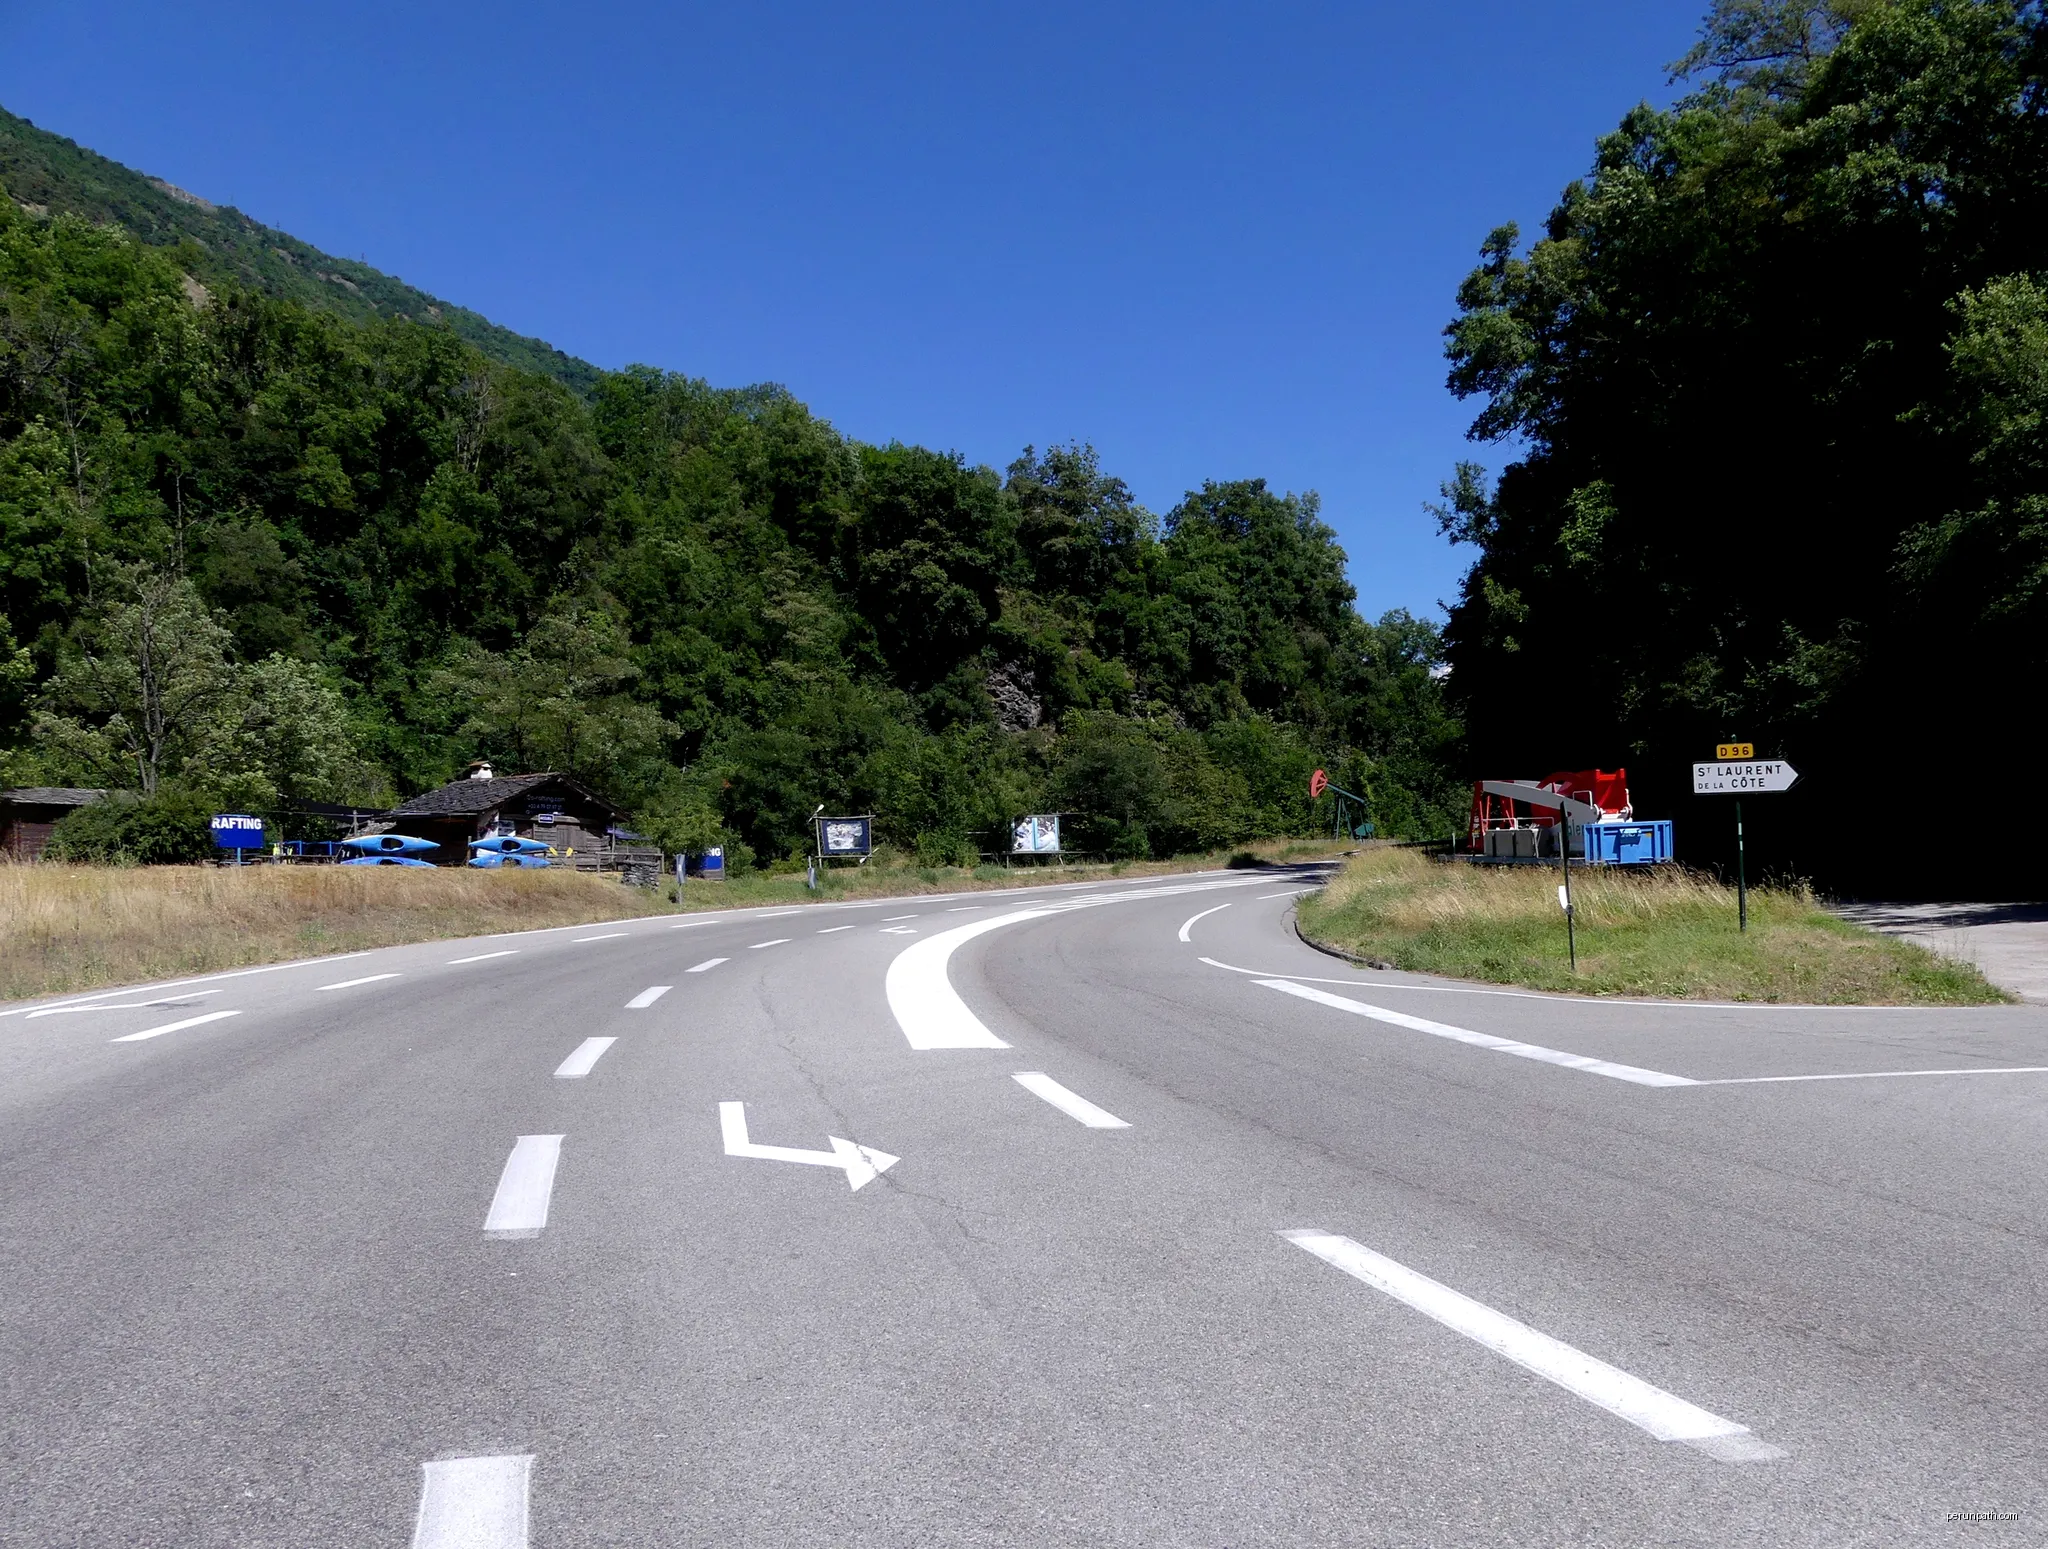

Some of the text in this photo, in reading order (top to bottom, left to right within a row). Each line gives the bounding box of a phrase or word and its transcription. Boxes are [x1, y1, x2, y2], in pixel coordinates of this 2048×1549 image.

[1720, 746, 1750, 756] D 96
[1717, 765, 1782, 776] LAURENT
[1731, 777, 1765, 788] CÔTE
[211, 817, 261, 829] RAFTING
